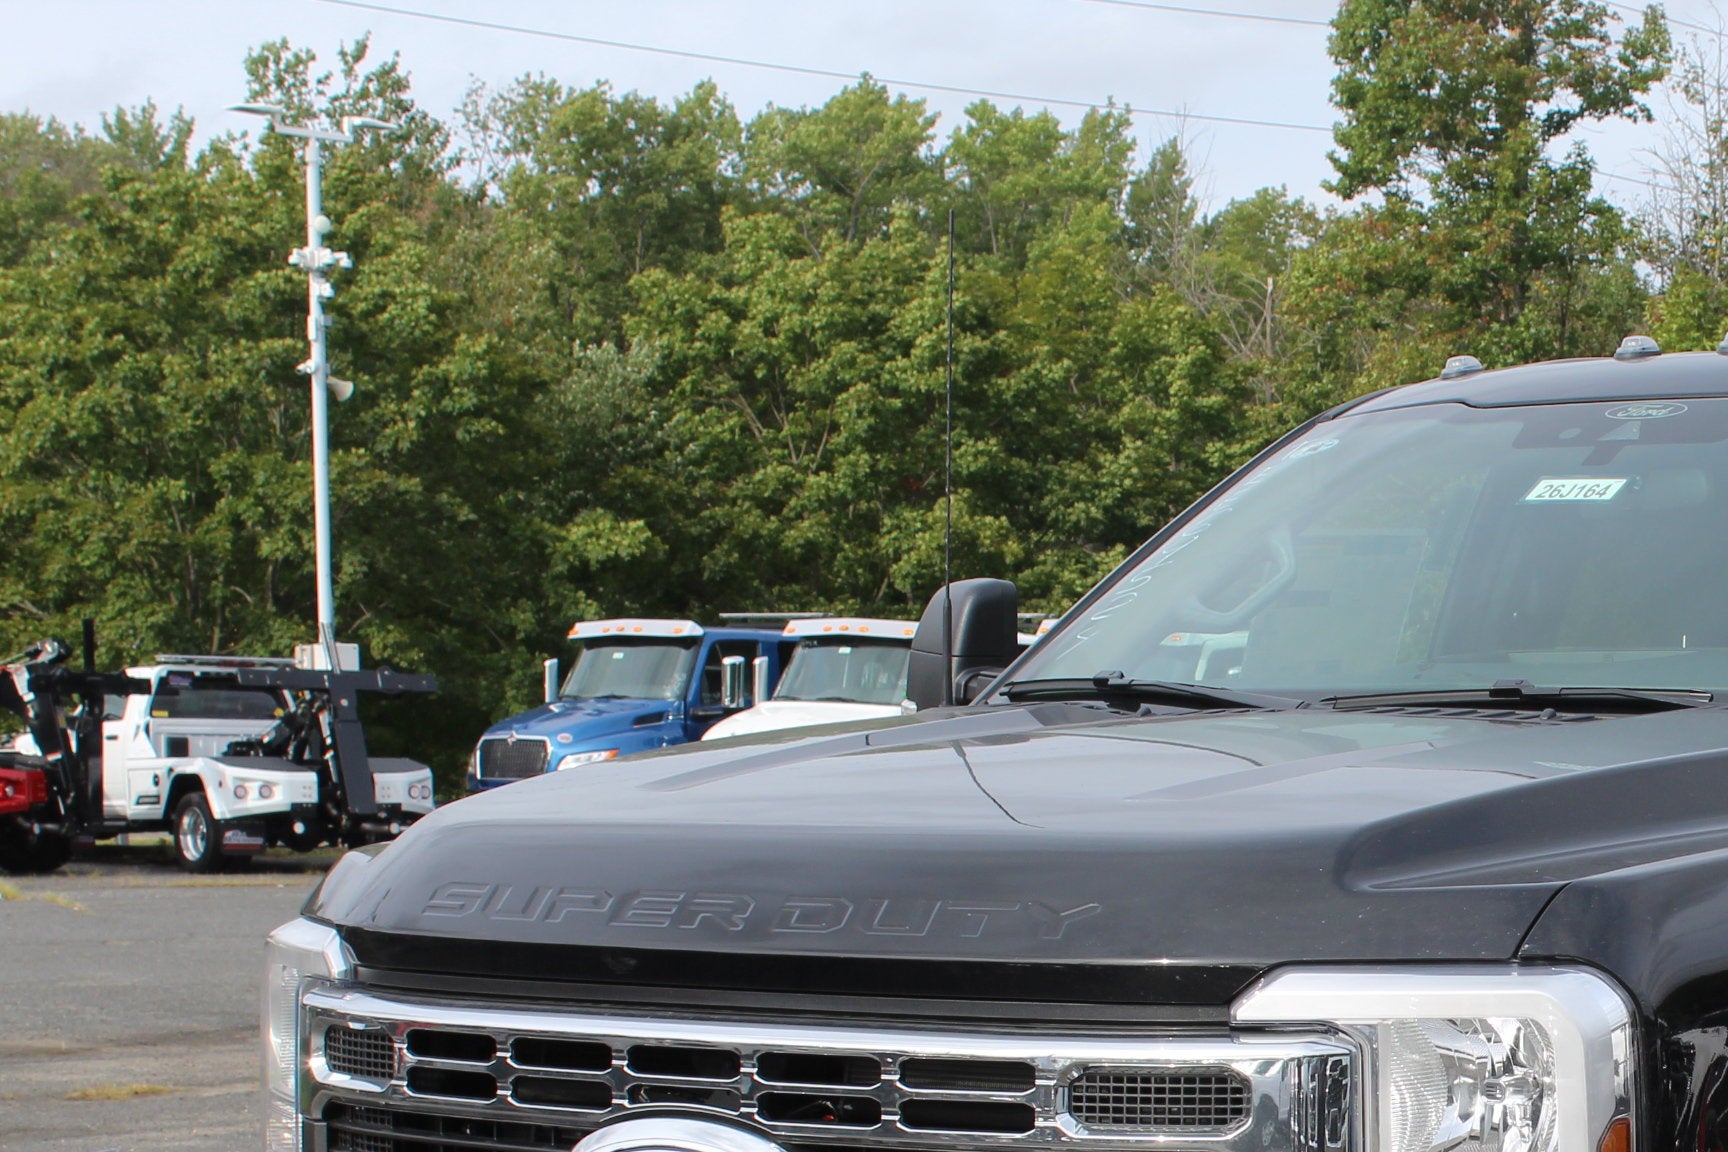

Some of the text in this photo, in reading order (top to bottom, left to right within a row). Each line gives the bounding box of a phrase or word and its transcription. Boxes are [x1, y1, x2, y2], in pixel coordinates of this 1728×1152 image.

[1617, 404, 1674, 417] Ford
[1535, 484, 1614, 499] 26J164
[422, 881, 1102, 939] SUPER DUTY
